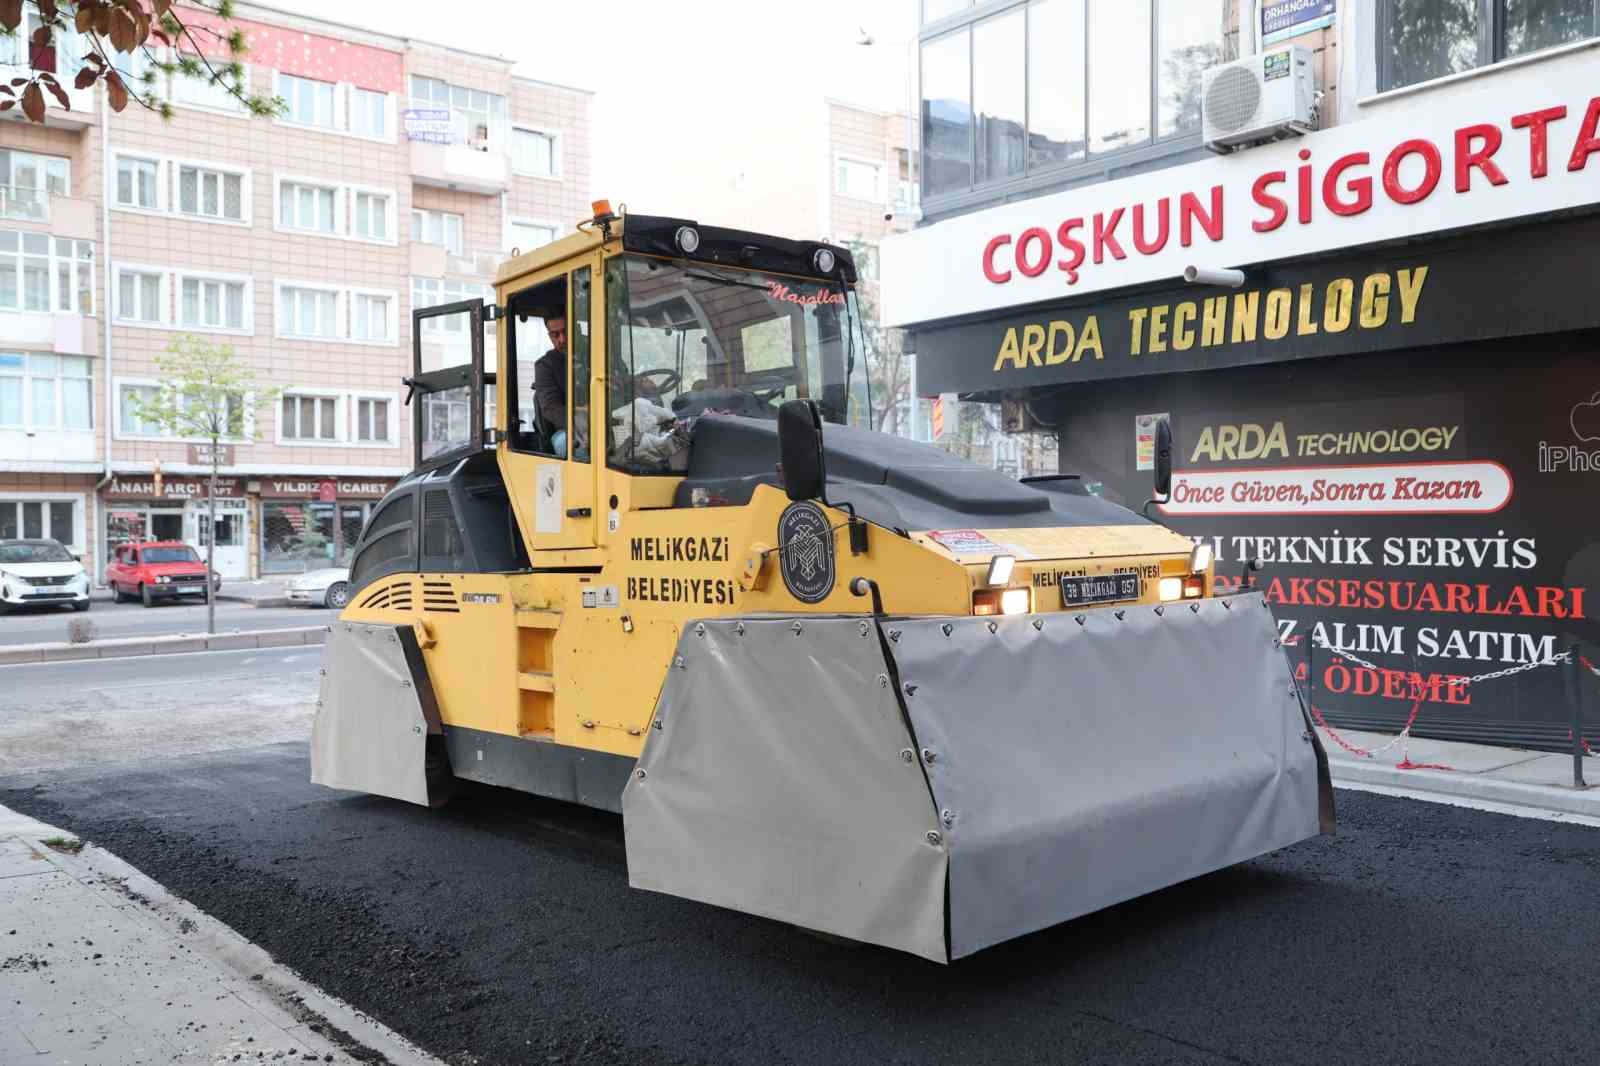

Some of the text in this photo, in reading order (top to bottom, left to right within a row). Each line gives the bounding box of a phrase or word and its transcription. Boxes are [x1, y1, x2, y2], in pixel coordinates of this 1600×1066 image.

[982, 97, 1600, 286] COŞKUN SİGORTA
[993, 265, 1429, 371] ARDA TECHNOLOGY
[1190, 421, 1290, 463] ARDA
[1296, 425, 1459, 457] TECHNOLOGY
[110, 482, 201, 495] ANAHARCI
[273, 480, 386, 493] YILDIZ İCARET
[1173, 479, 1225, 504] Önce
[1391, 476, 1483, 501] Kazan
[1231, 528, 1374, 565] TEKNİK
[1383, 529, 1538, 569] SERVİS
[1121, 579, 1136, 594] 057
[1265, 574, 1587, 619] AKSESUARLARI
[1311, 621, 1405, 655] ALIM
[1416, 626, 1557, 666] SATIM
[1323, 657, 1472, 705] ÖDEME
